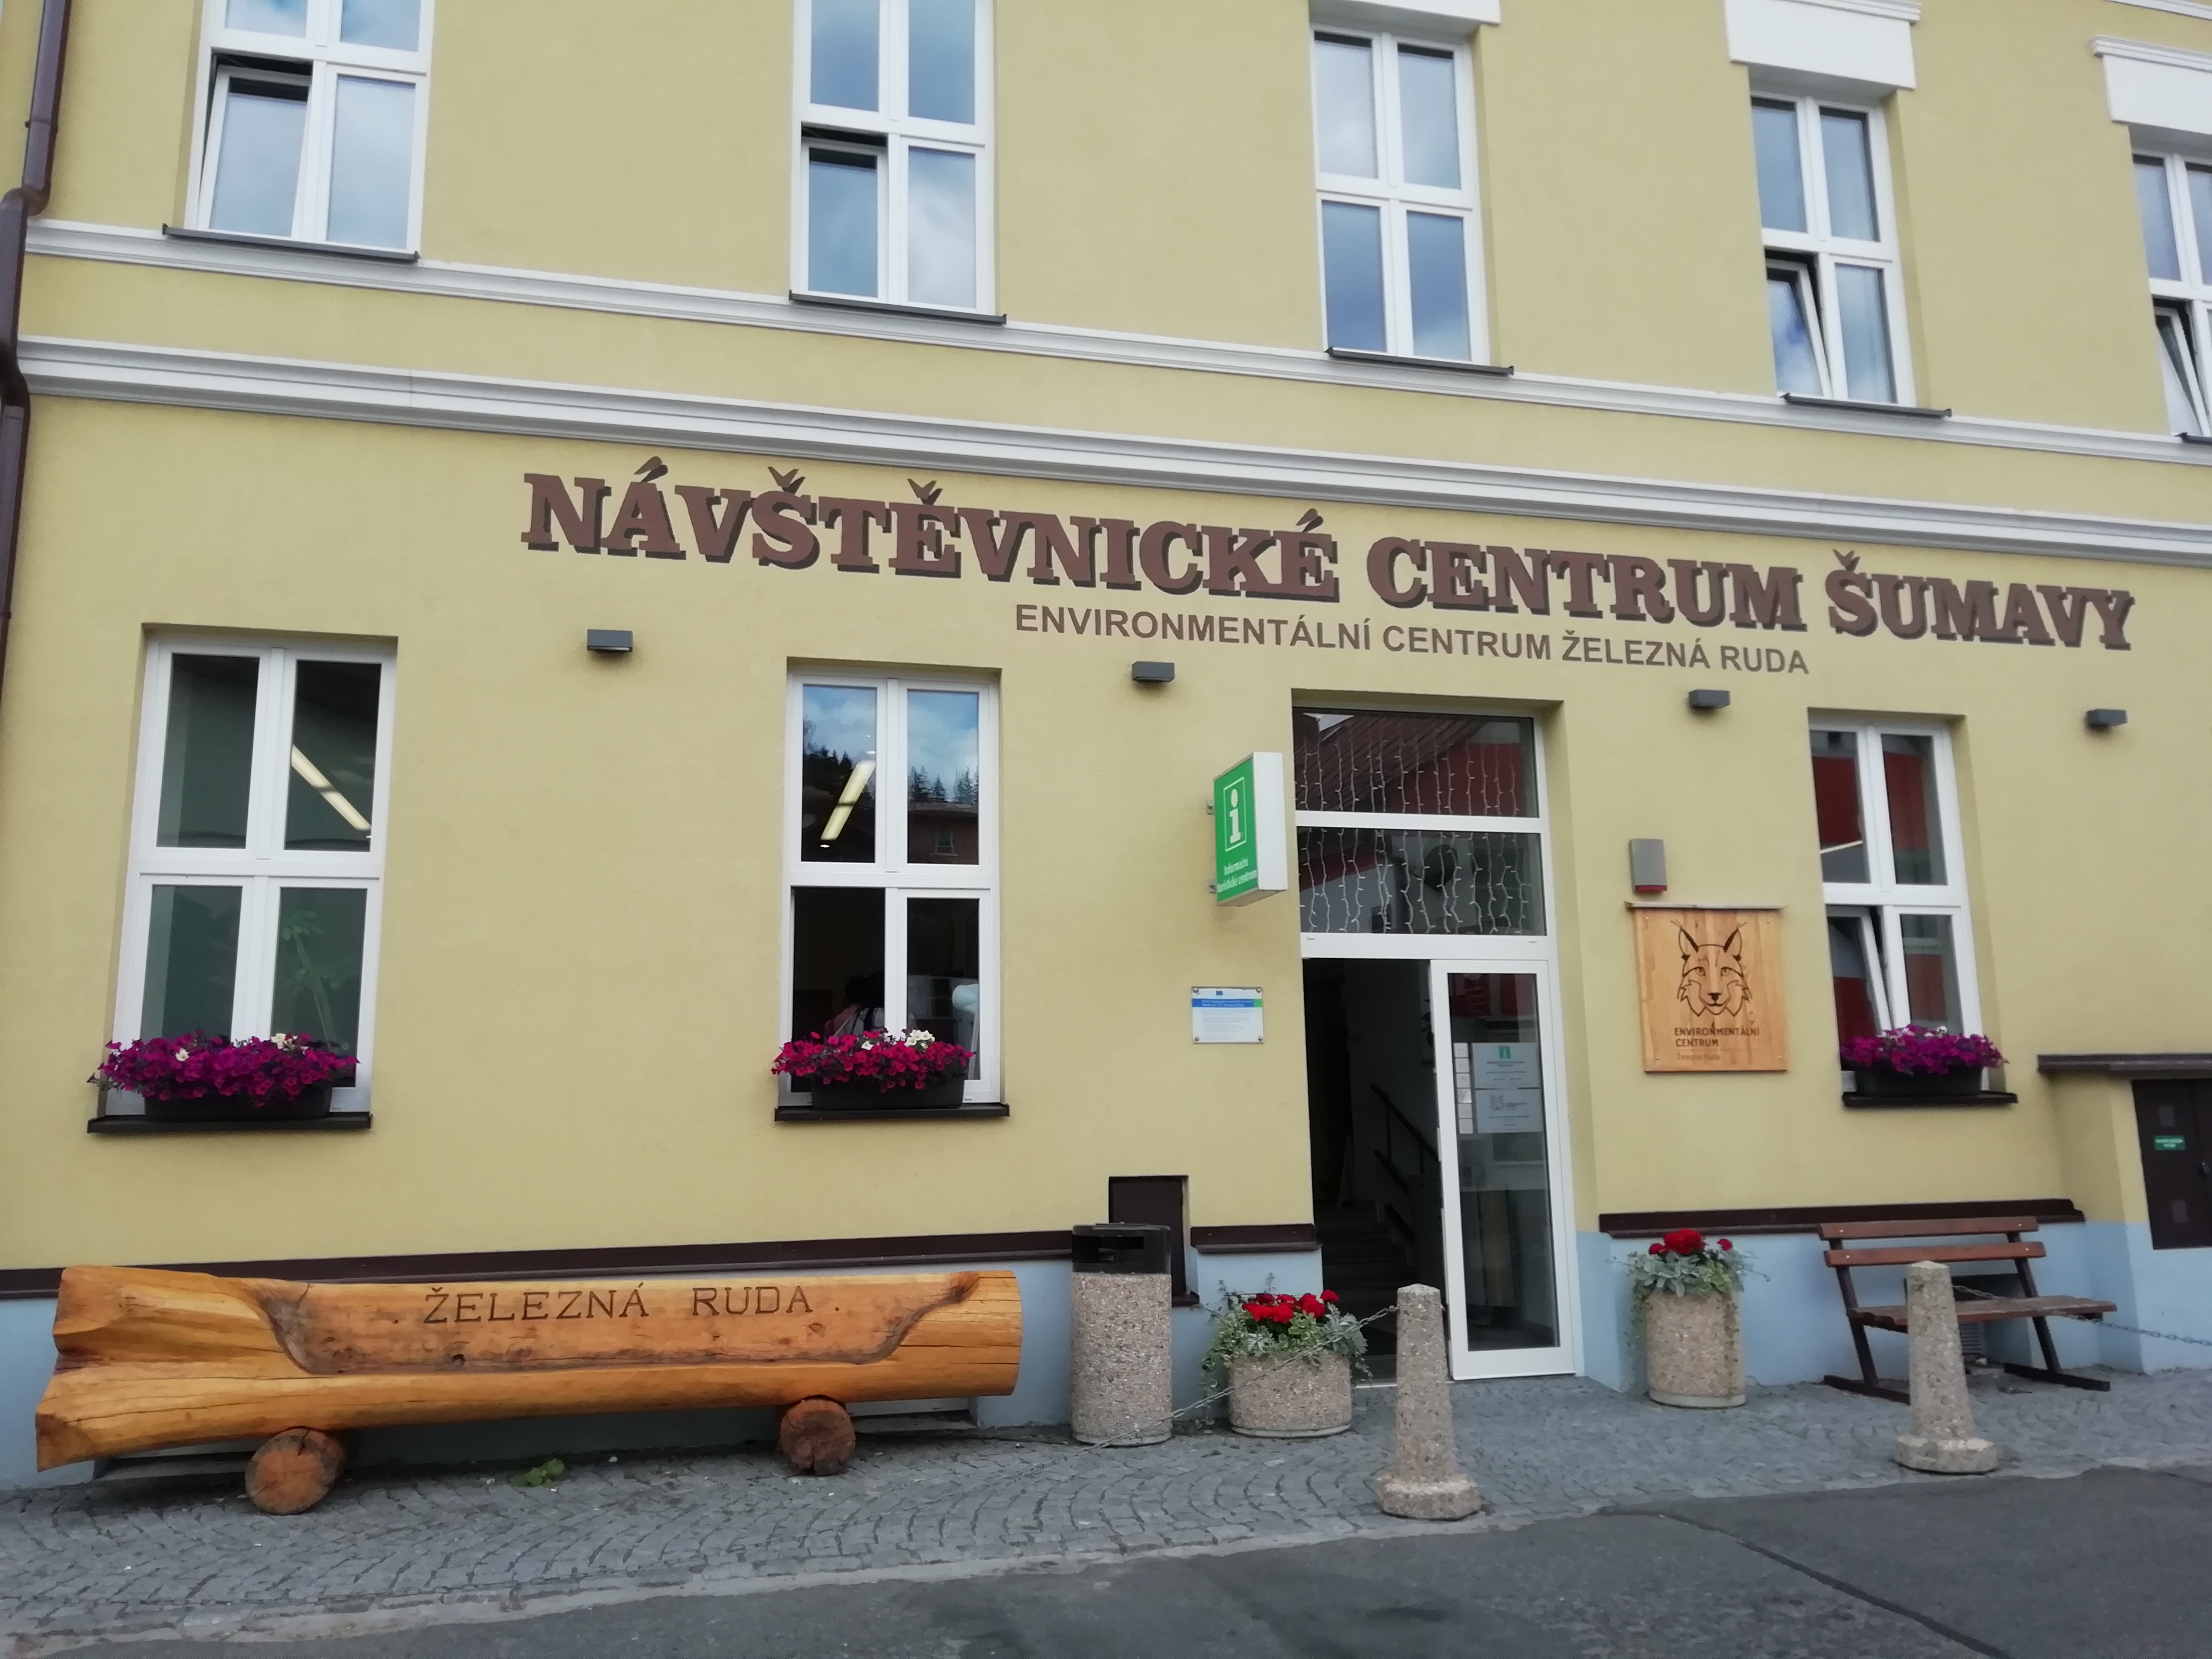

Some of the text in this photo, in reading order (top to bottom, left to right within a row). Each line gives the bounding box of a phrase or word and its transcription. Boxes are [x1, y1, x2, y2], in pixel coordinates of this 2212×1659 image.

[521, 456, 2135, 650] NÁVŠTĚVNICKÉ CENTRUM ŠUMAVY
[1016, 604, 1809, 674] ENVIRONMENTÁLNÍ CENTRUM ŽELEZNÁ RUDA
[1674, 1026, 1760, 1036] ENVIRONMENTÁLNÍ
[1675, 1038, 1719, 1047] CENTRUM
[424, 1282, 814, 1323] ŽELEZNÁ RUDA
